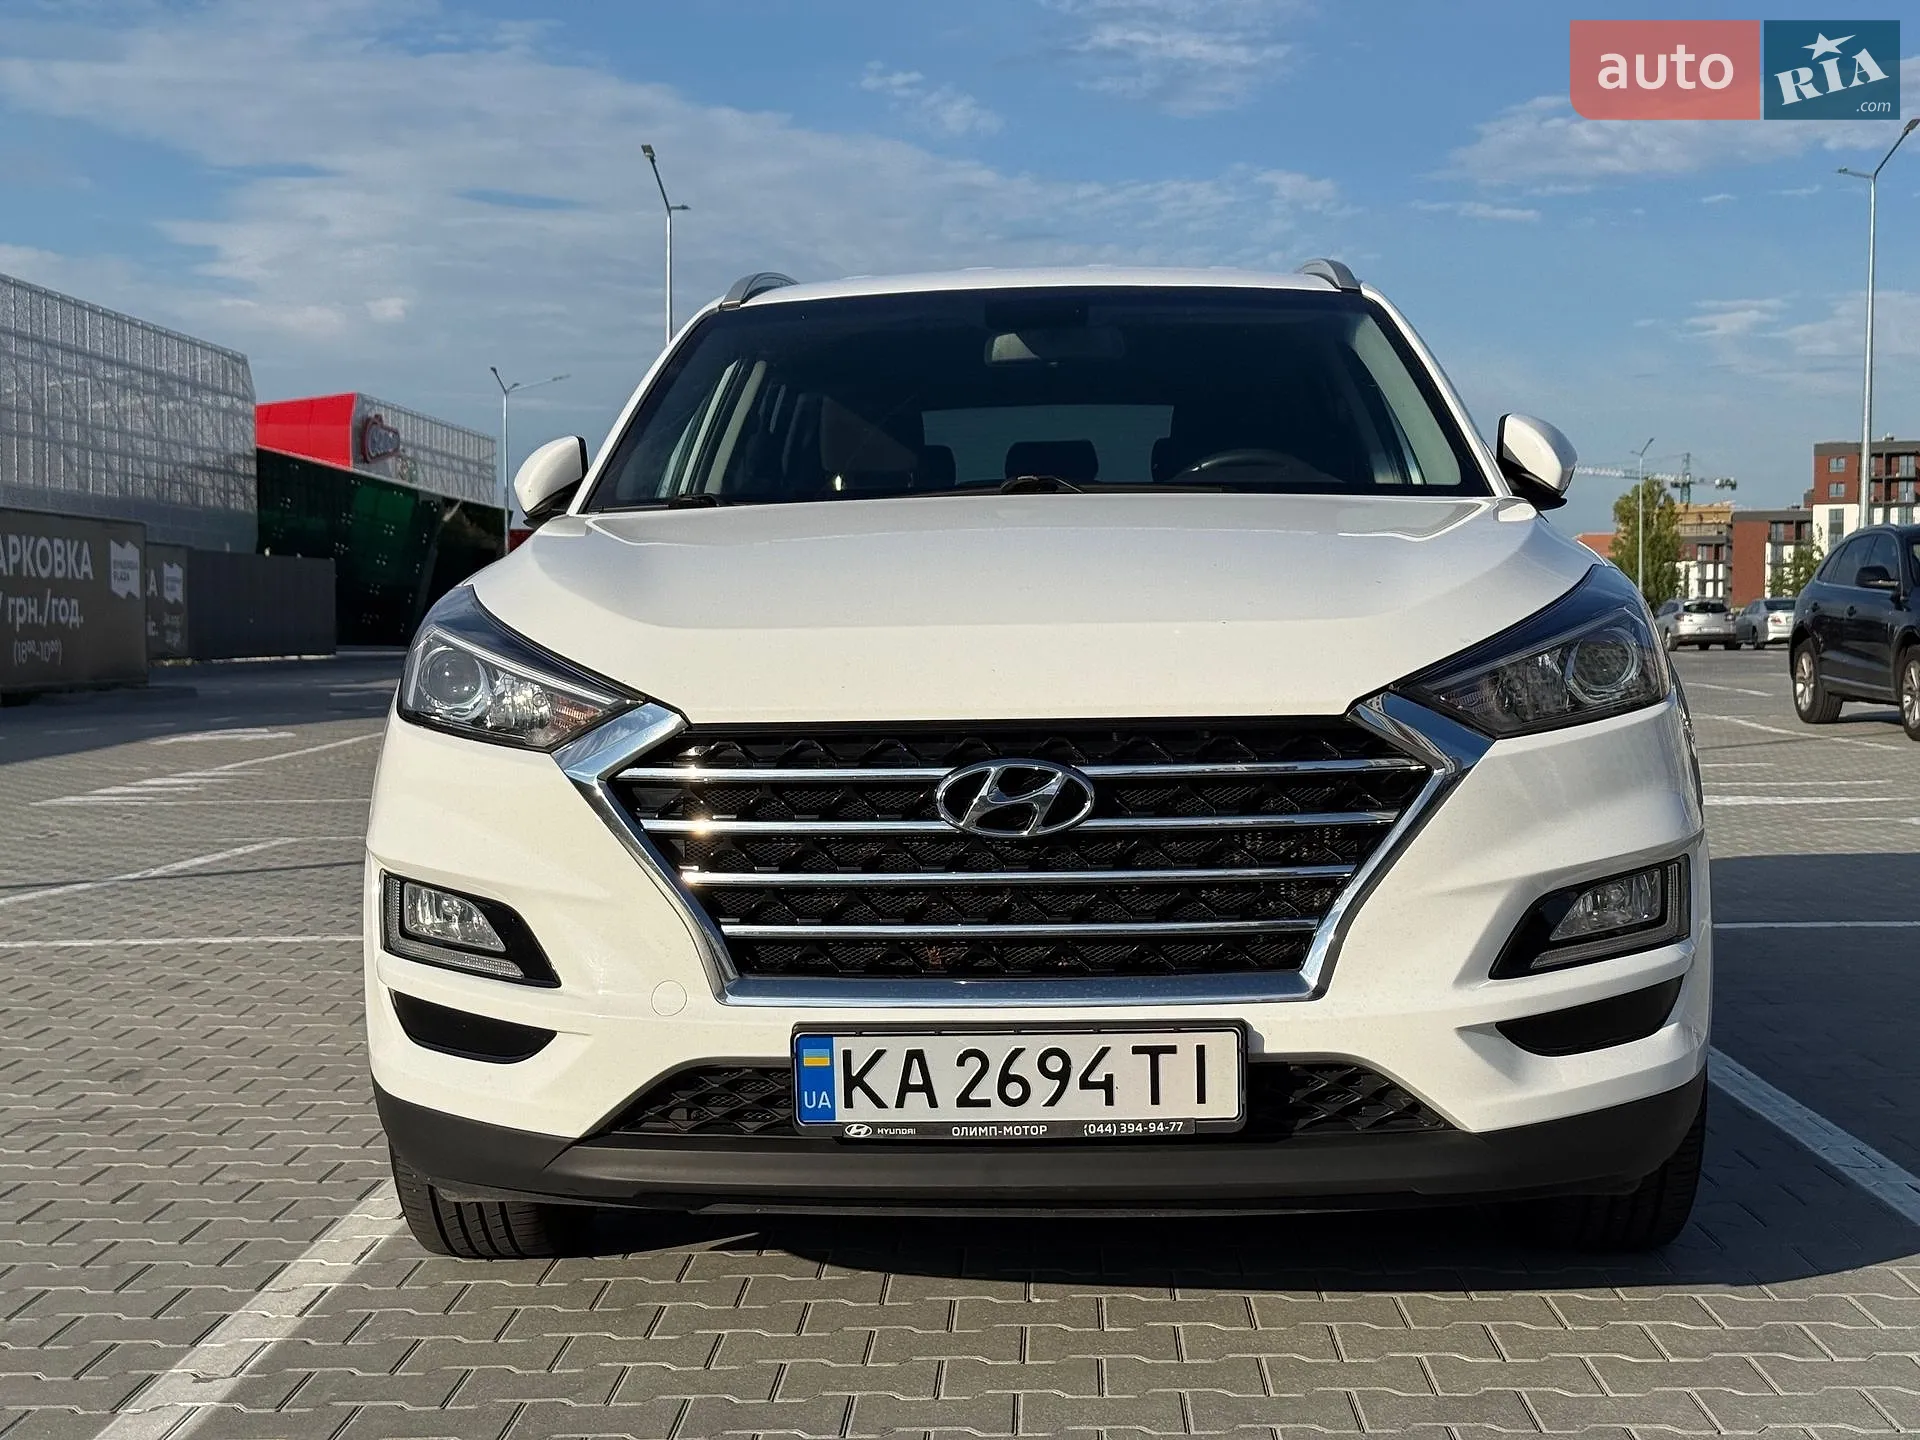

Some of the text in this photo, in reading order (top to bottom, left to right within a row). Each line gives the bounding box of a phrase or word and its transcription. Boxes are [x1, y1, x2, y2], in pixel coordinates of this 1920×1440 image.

[842, 1044, 1206, 1109] KA 2694 TI
[804, 1091, 832, 1109] UA
[877, 1127, 917, 1135] HYUNDAI
[951, 1123, 1048, 1137] ОЛИМП-МОТОР
[1119, 1121, 1184, 1135] 394-94-77
